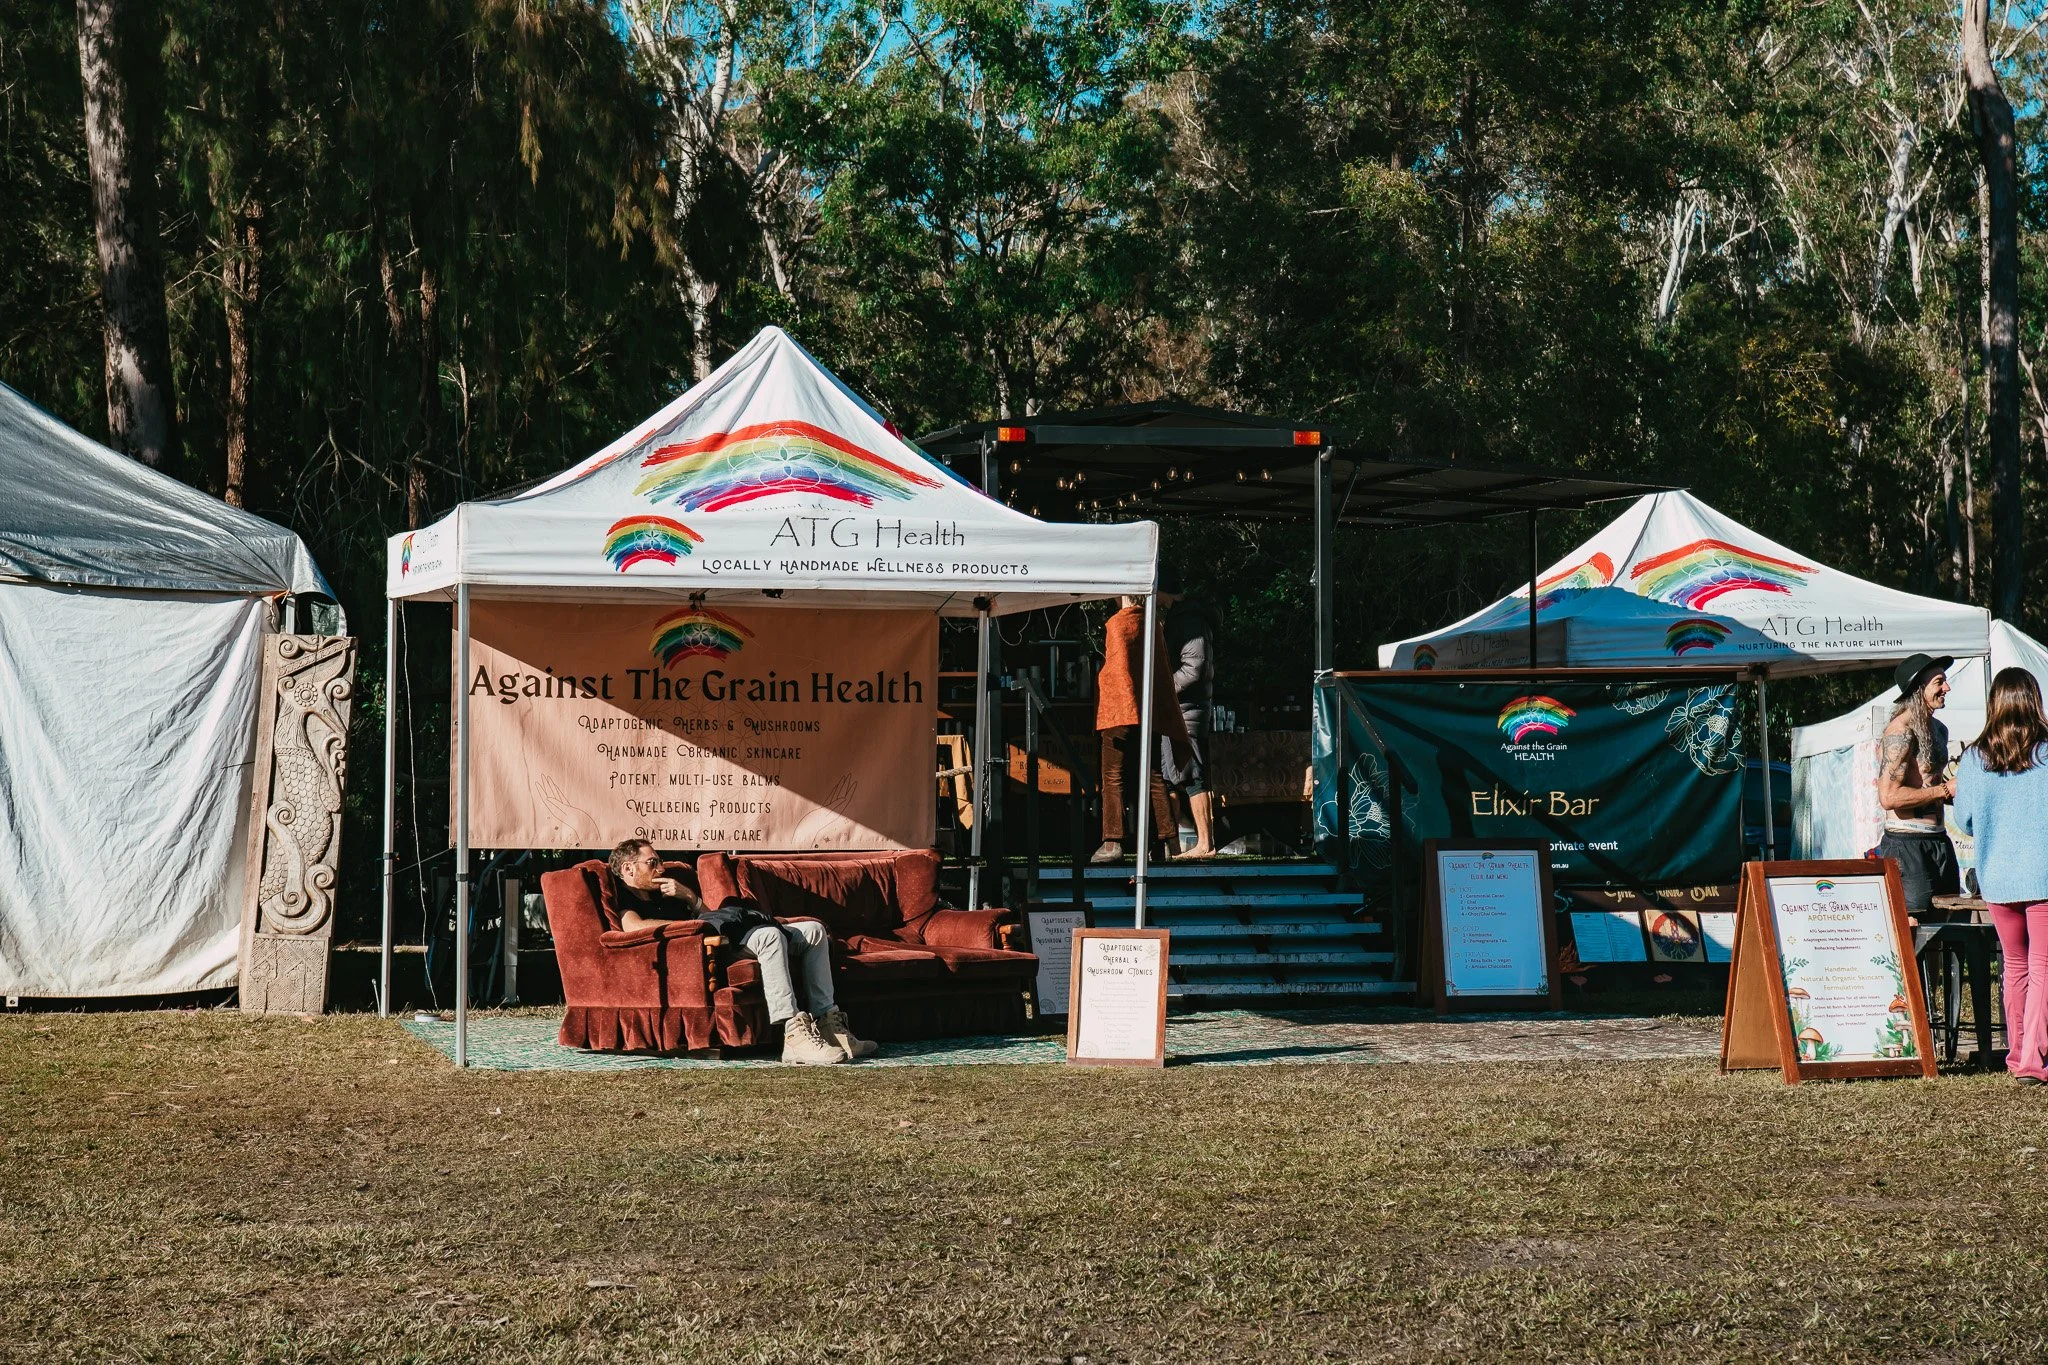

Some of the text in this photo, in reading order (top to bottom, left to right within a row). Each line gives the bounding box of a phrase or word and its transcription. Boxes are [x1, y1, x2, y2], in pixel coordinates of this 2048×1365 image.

[770, 517, 964, 548] ATG Health
[702, 558, 1028, 575] LOCALLY HANDMADE WELLNESS PRODUCTS
[1759, 616, 1883, 636] ATG Health
[1739, 642, 1796, 651] NURTURING
[1826, 640, 1864, 648] NATURE
[1869, 639, 1903, 647] WITHIN
[469, 664, 923, 705] Against The Grain Health
[577, 715, 820, 735] ADAPTOGENIC HERBS & MUSHROOMS
[597, 743, 802, 761] HANDMADE ORGANIC SKINCARE
[1500, 742, 1530, 752] Against
[1532, 742, 1544, 750] the
[1514, 753, 1555, 762] HEALTH
[669, 774, 734, 787] MULTI-USE
[742, 774, 781, 788] BALMS
[1471, 783, 1600, 817] Elixir Bar
[626, 799, 772, 817] WELLBEING PRODUCTS
[635, 826, 762, 844] NATURAL SUN CARE
[1588, 841, 1618, 850] event
[1781, 901, 1878, 915] AGAINST THE GRAIN HEALTH
[1808, 914, 1856, 922] APOTHECARY
[1099, 943, 1143, 952] ADAPTOGENIC
[1103, 955, 1130, 965] HERBAL
[1087, 966, 1153, 978] MUSHROOM TONICS
